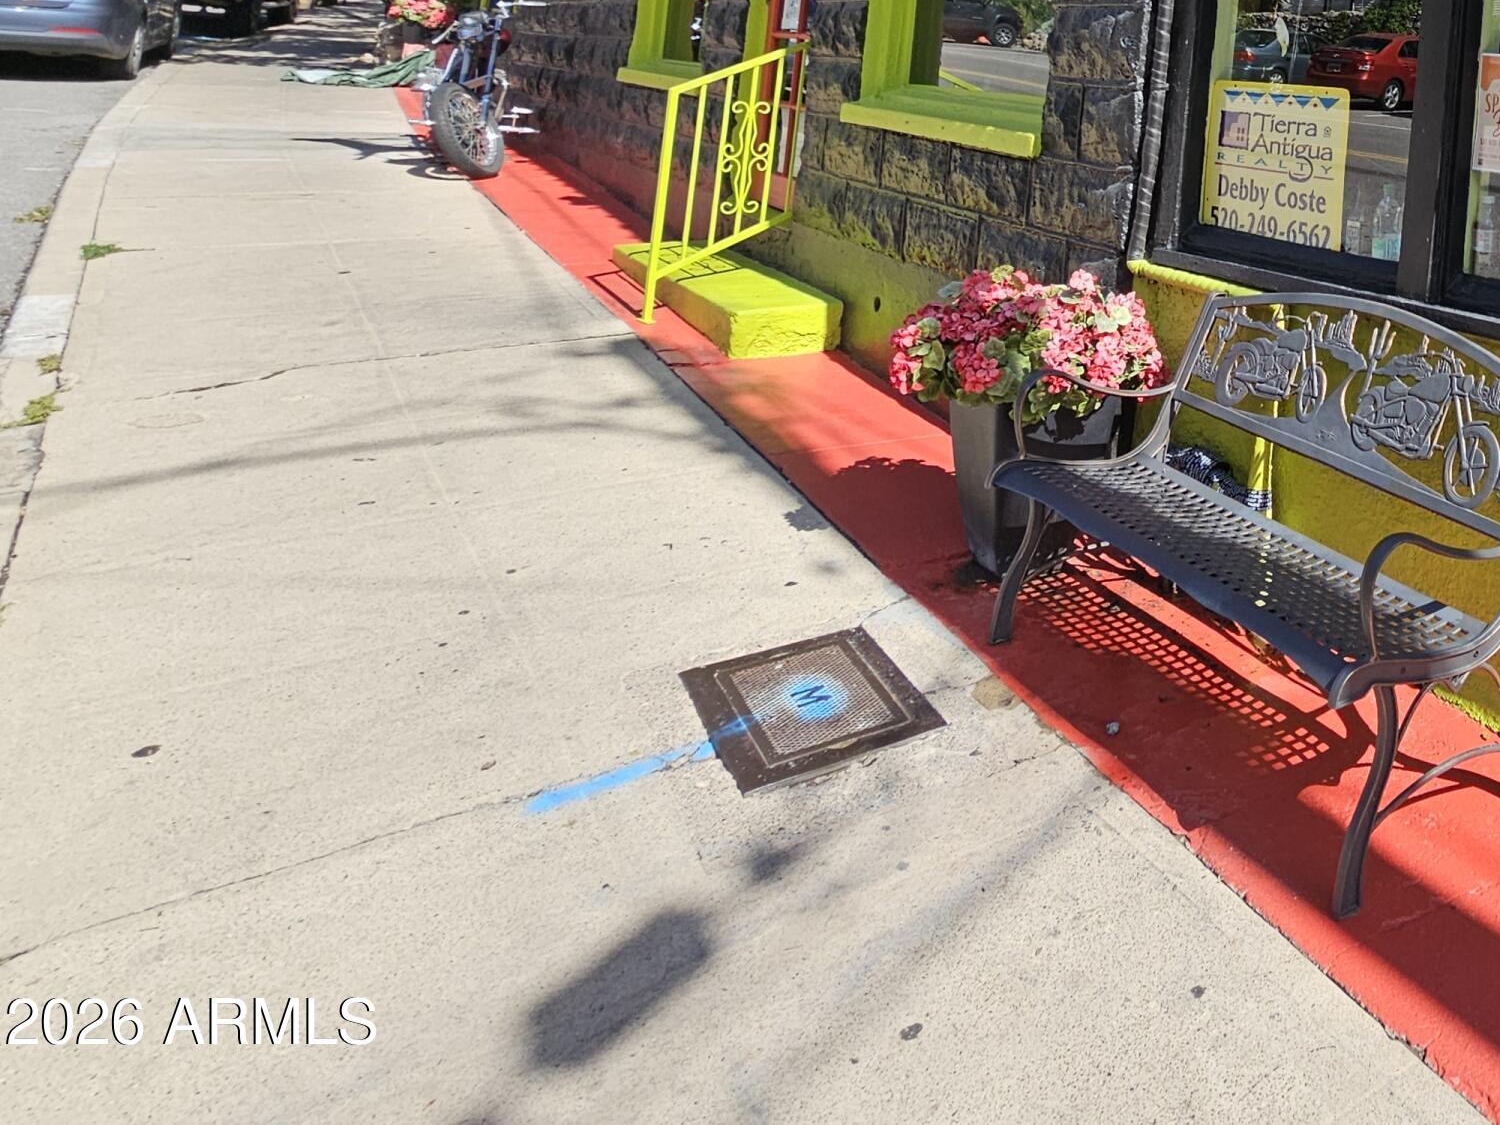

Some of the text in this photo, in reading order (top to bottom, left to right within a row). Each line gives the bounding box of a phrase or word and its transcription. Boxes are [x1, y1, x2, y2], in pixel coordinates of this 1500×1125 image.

[1252, 112, 1318, 137] Tierra
[1217, 152, 1333, 175] REALTY
[1251, 134, 1333, 174] Antigua
[1217, 174, 1327, 215] Debby Coste
[1210, 206, 1331, 249] 520-249-6562
